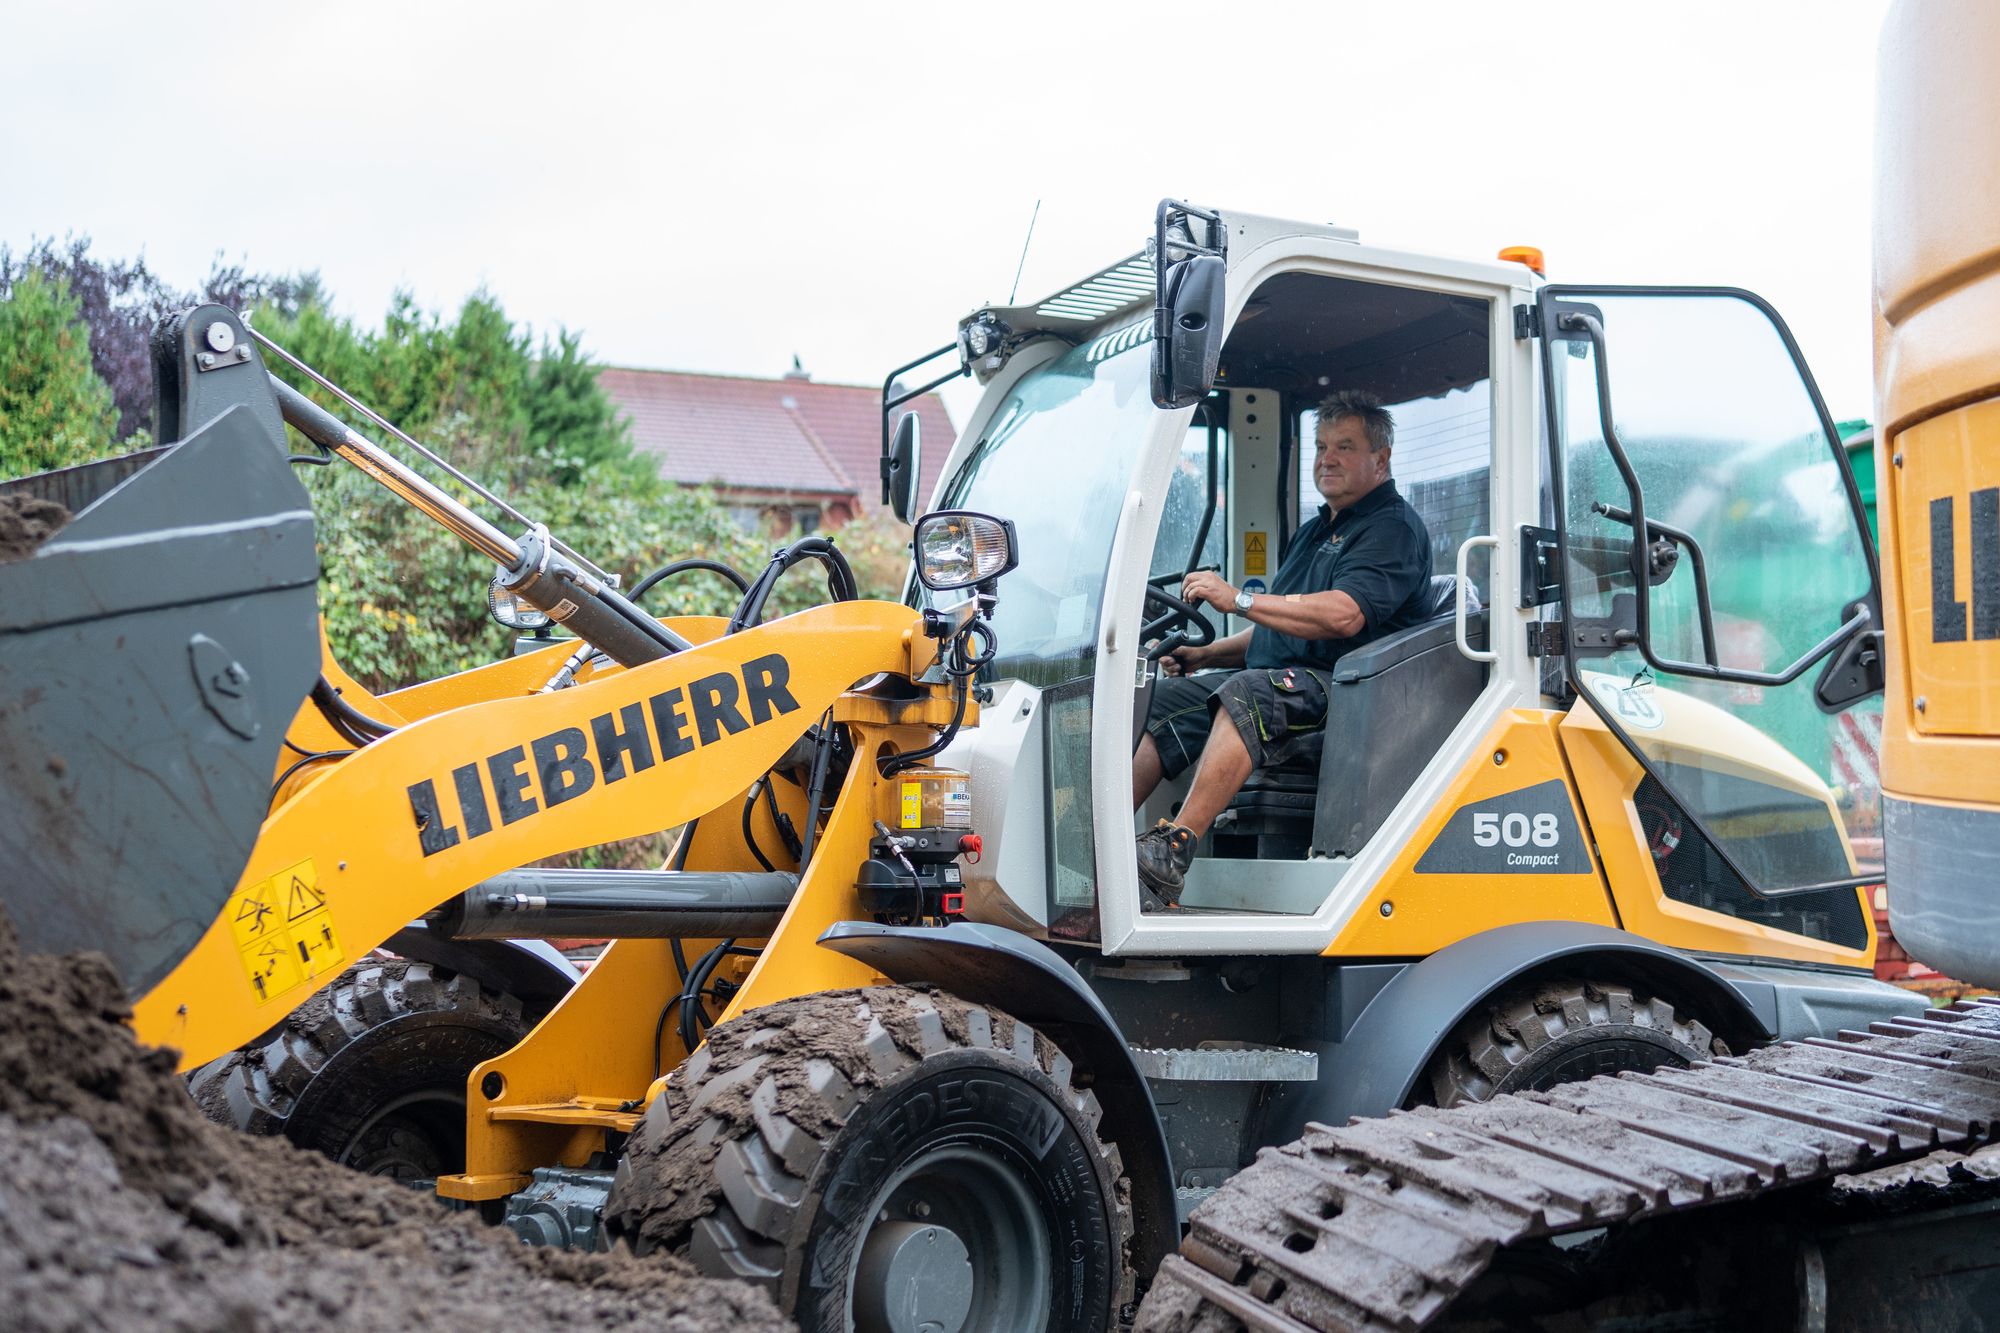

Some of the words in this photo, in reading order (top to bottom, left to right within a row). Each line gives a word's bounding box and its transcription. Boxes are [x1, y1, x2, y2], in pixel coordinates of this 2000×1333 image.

[407, 653, 801, 858] LIEBHERR
[1473, 812, 1560, 848] 508
[1507, 853, 1559, 867] Compact
